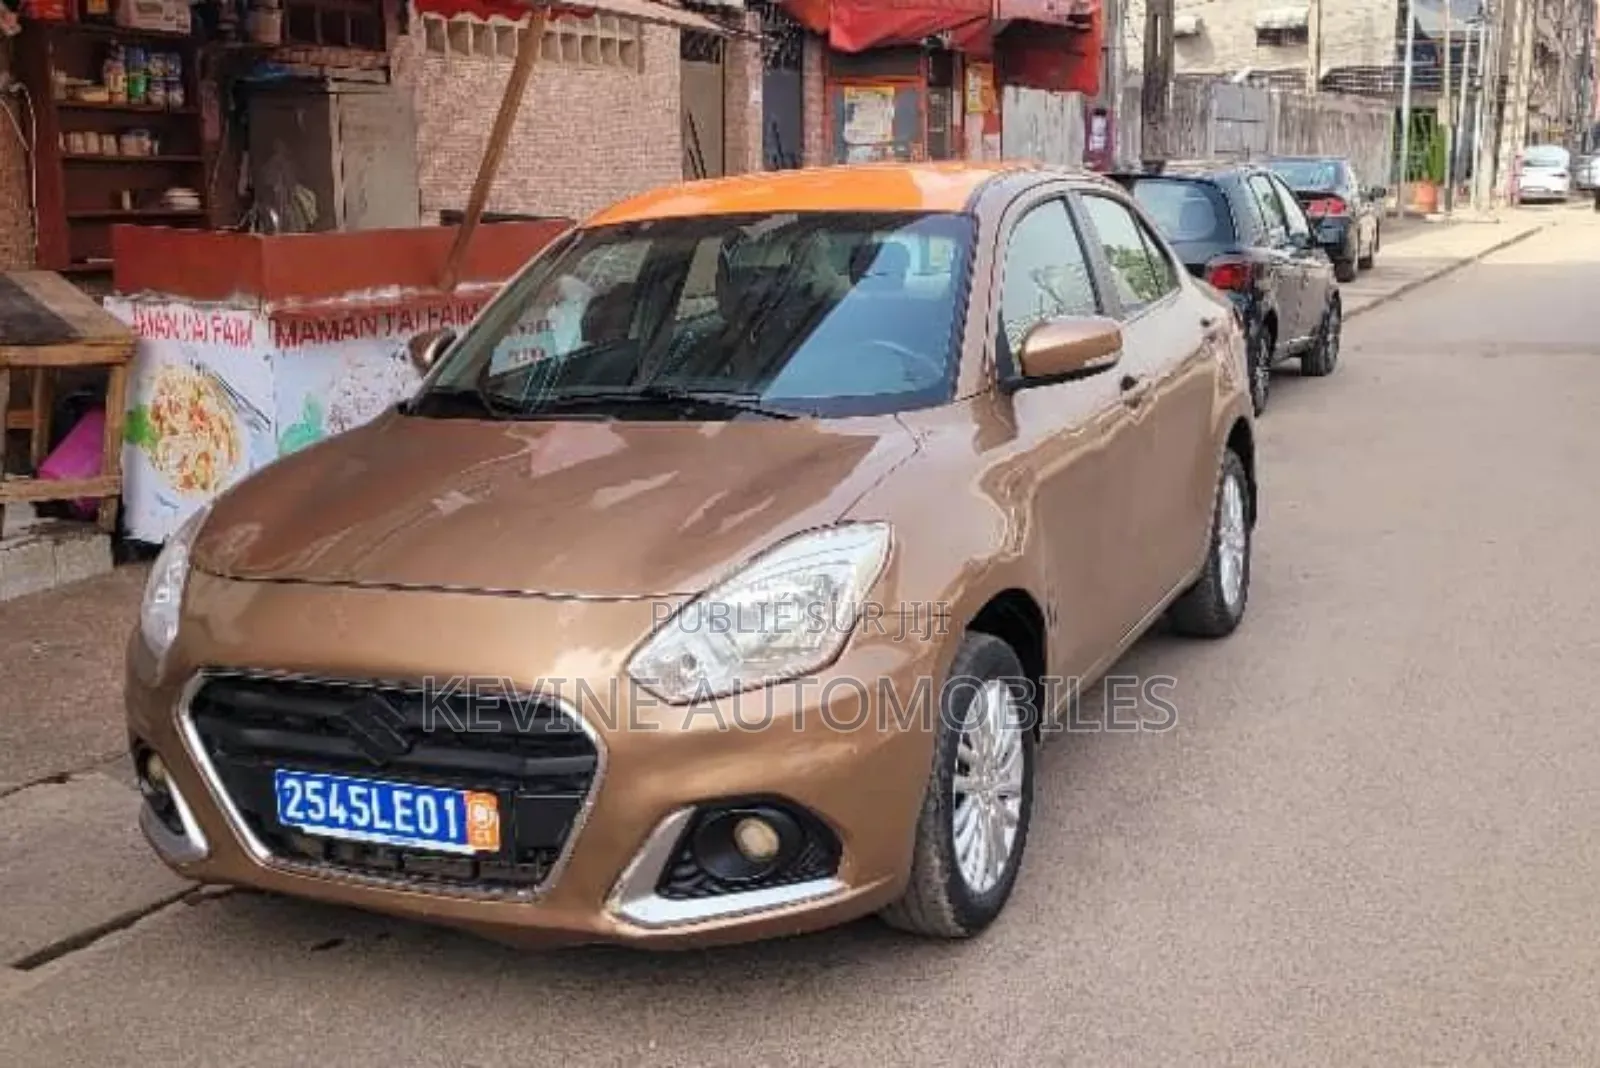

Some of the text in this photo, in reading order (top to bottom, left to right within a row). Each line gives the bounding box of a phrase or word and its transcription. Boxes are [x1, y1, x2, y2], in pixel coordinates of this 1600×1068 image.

[210, 311, 254, 348] FAIM
[274, 314, 377, 348] MAMAN
[426, 302, 479, 333] FAIM
[281, 777, 459, 840] 2545LE01
